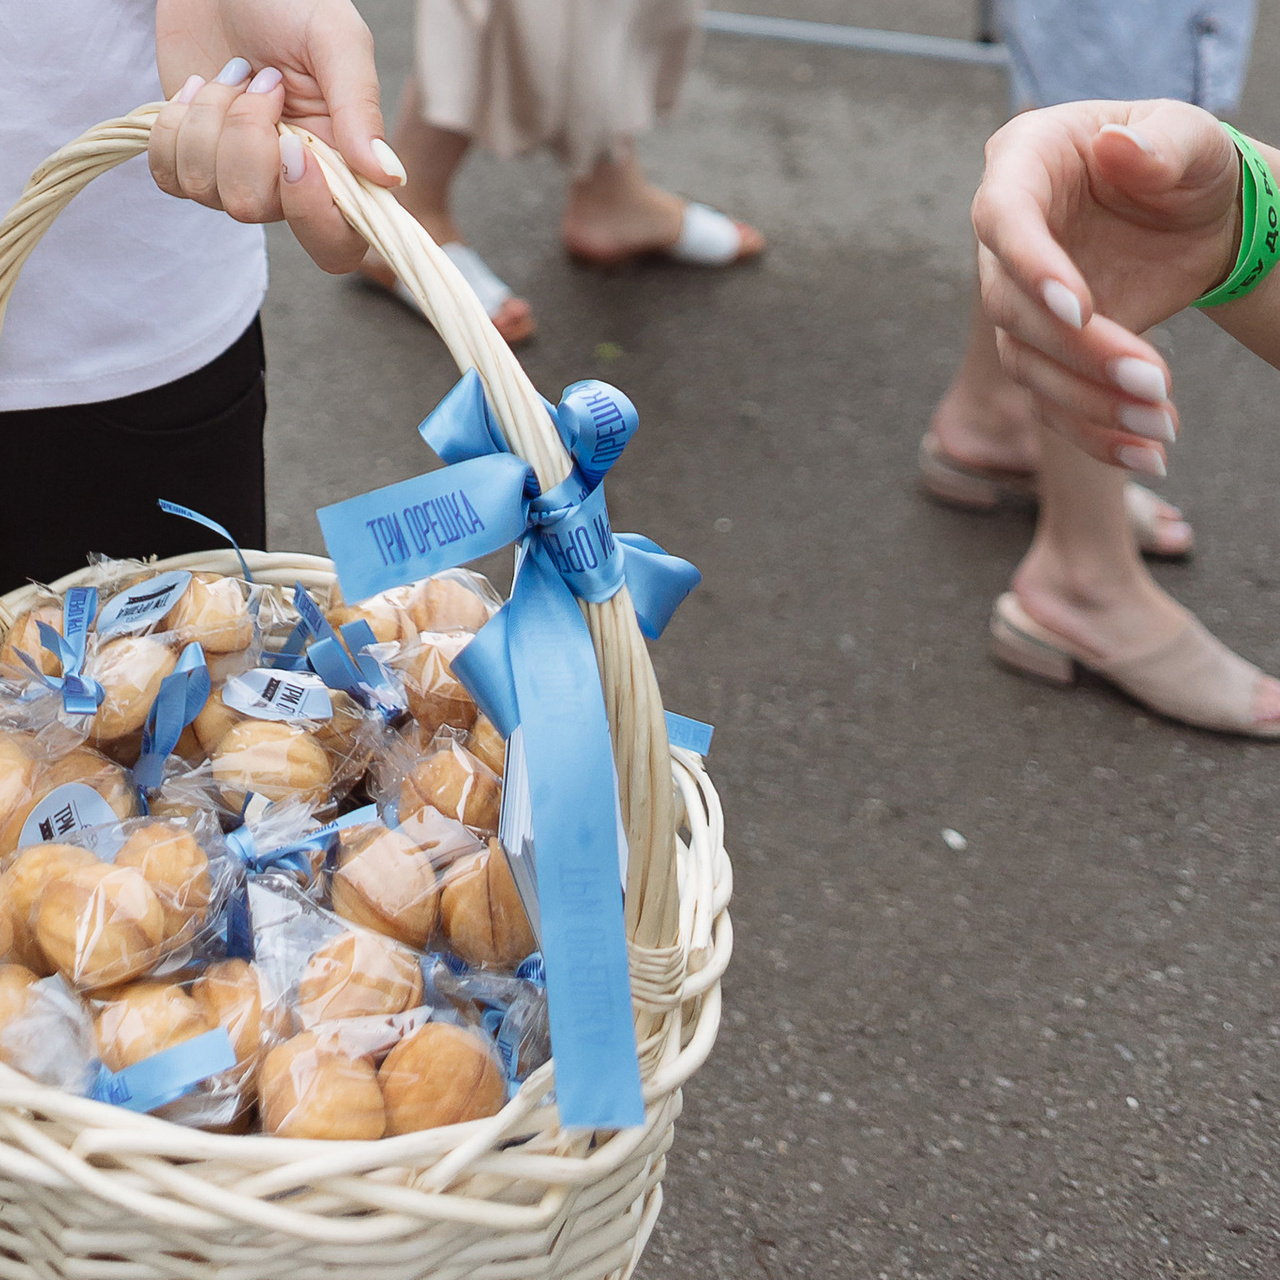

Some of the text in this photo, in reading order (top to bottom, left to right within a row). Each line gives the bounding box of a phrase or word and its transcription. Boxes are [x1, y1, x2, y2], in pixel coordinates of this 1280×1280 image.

[1265, 205, 1280, 254] ДО
[365, 489, 486, 566] ТРИ ОРЕШКА
[66, 613, 83, 638] ТРИ
[280, 682, 305, 705] ТРИ
[54, 802, 76, 836] ТРИ
